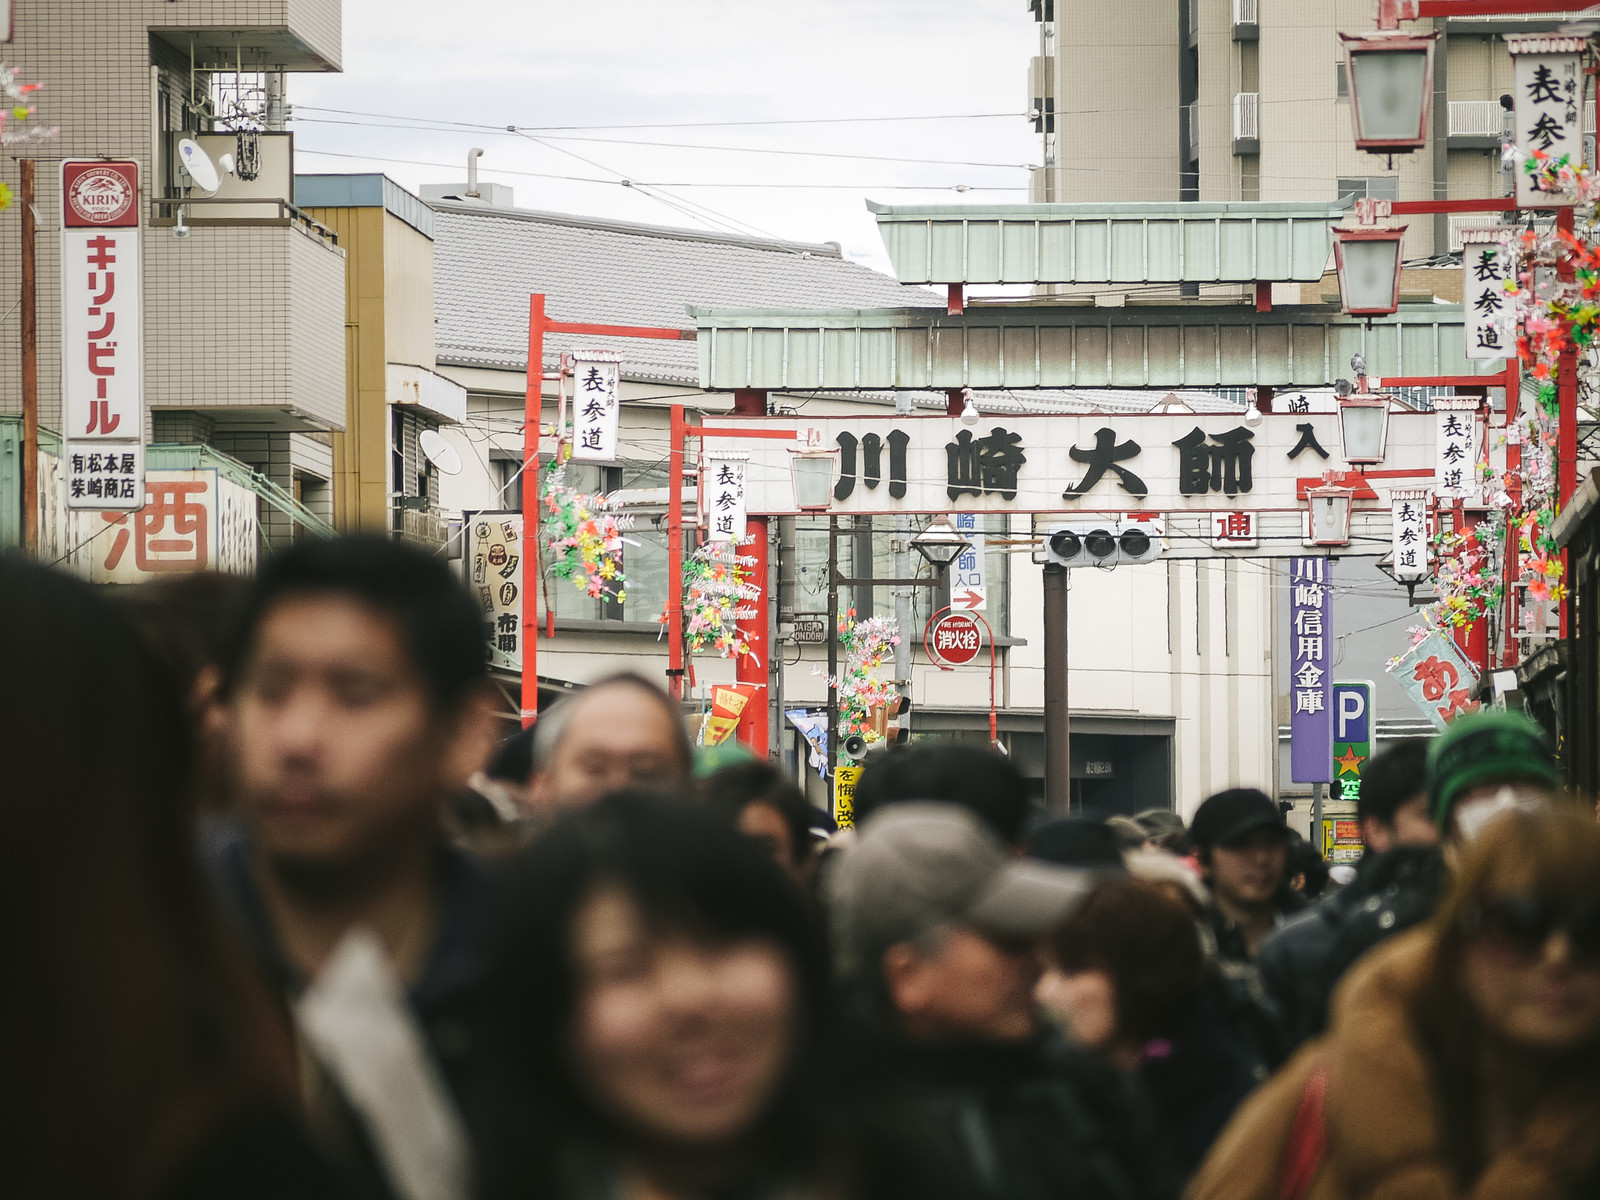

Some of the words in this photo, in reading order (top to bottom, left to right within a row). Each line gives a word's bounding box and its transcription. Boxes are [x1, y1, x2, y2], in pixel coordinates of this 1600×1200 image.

[1526, 64, 1566, 192] 表参
[83, 195, 119, 205] KIRIN
[86, 235, 120, 435] キリンビール
[1473, 250, 1503, 350] 表参道
[581, 366, 606, 451] 表参道
[1442, 414, 1466, 489] 表参道
[71, 478, 136, 499] 柴崎商店
[716, 463, 737, 535] 表参道
[101, 481, 208, 572] 酒
[1216, 512, 1252, 542] 通
[1398, 502, 1418, 568] 表参道
[955, 573, 981, 587] 入口
[938, 629, 978, 650] 消火栓
[1294, 557, 1325, 715] 川崎信用金庫
[1339, 691, 1365, 738] P
